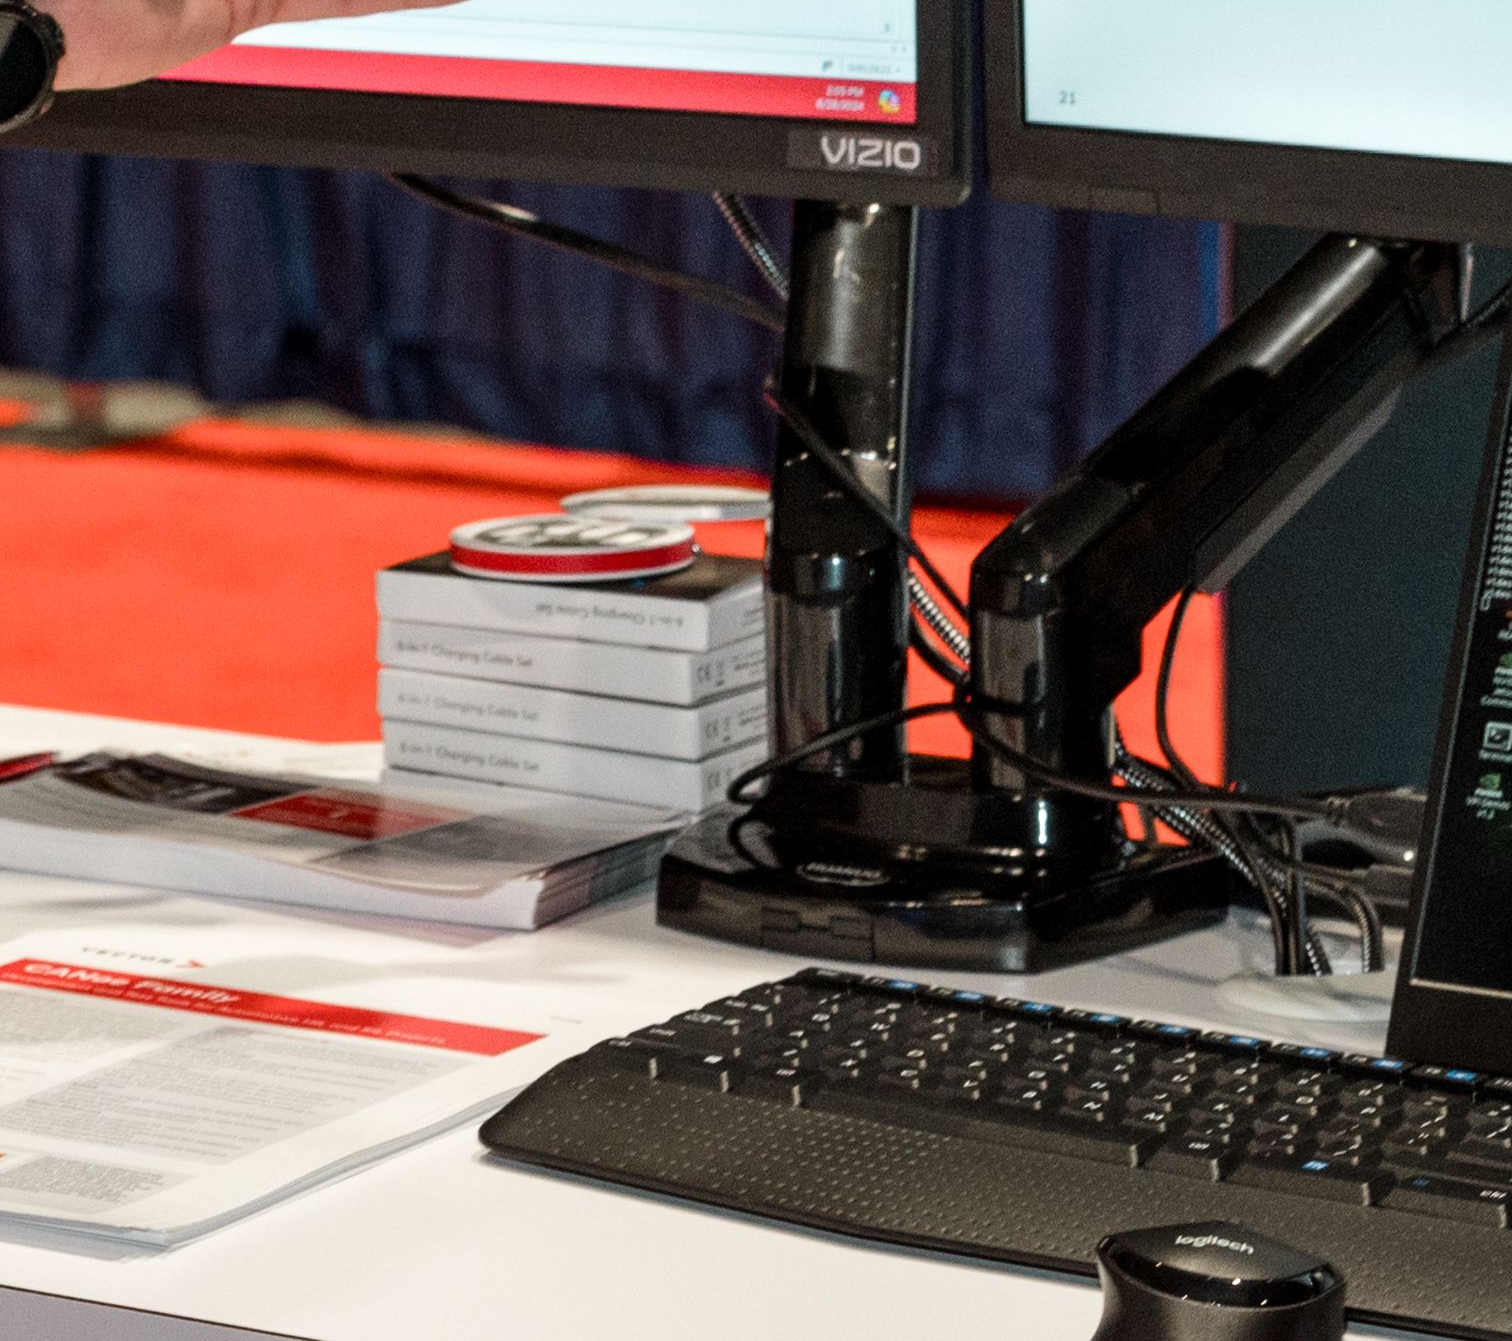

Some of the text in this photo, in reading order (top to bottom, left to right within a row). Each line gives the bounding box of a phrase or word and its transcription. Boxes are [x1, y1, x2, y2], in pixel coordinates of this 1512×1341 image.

[1058, 90, 1075, 105] 21
[820, 135, 921, 170] VIZIO
[81, 945, 174, 965] VECTOR
[23, 963, 240, 1004] CANoe Family
[1174, 1234, 1254, 1255] logitech
